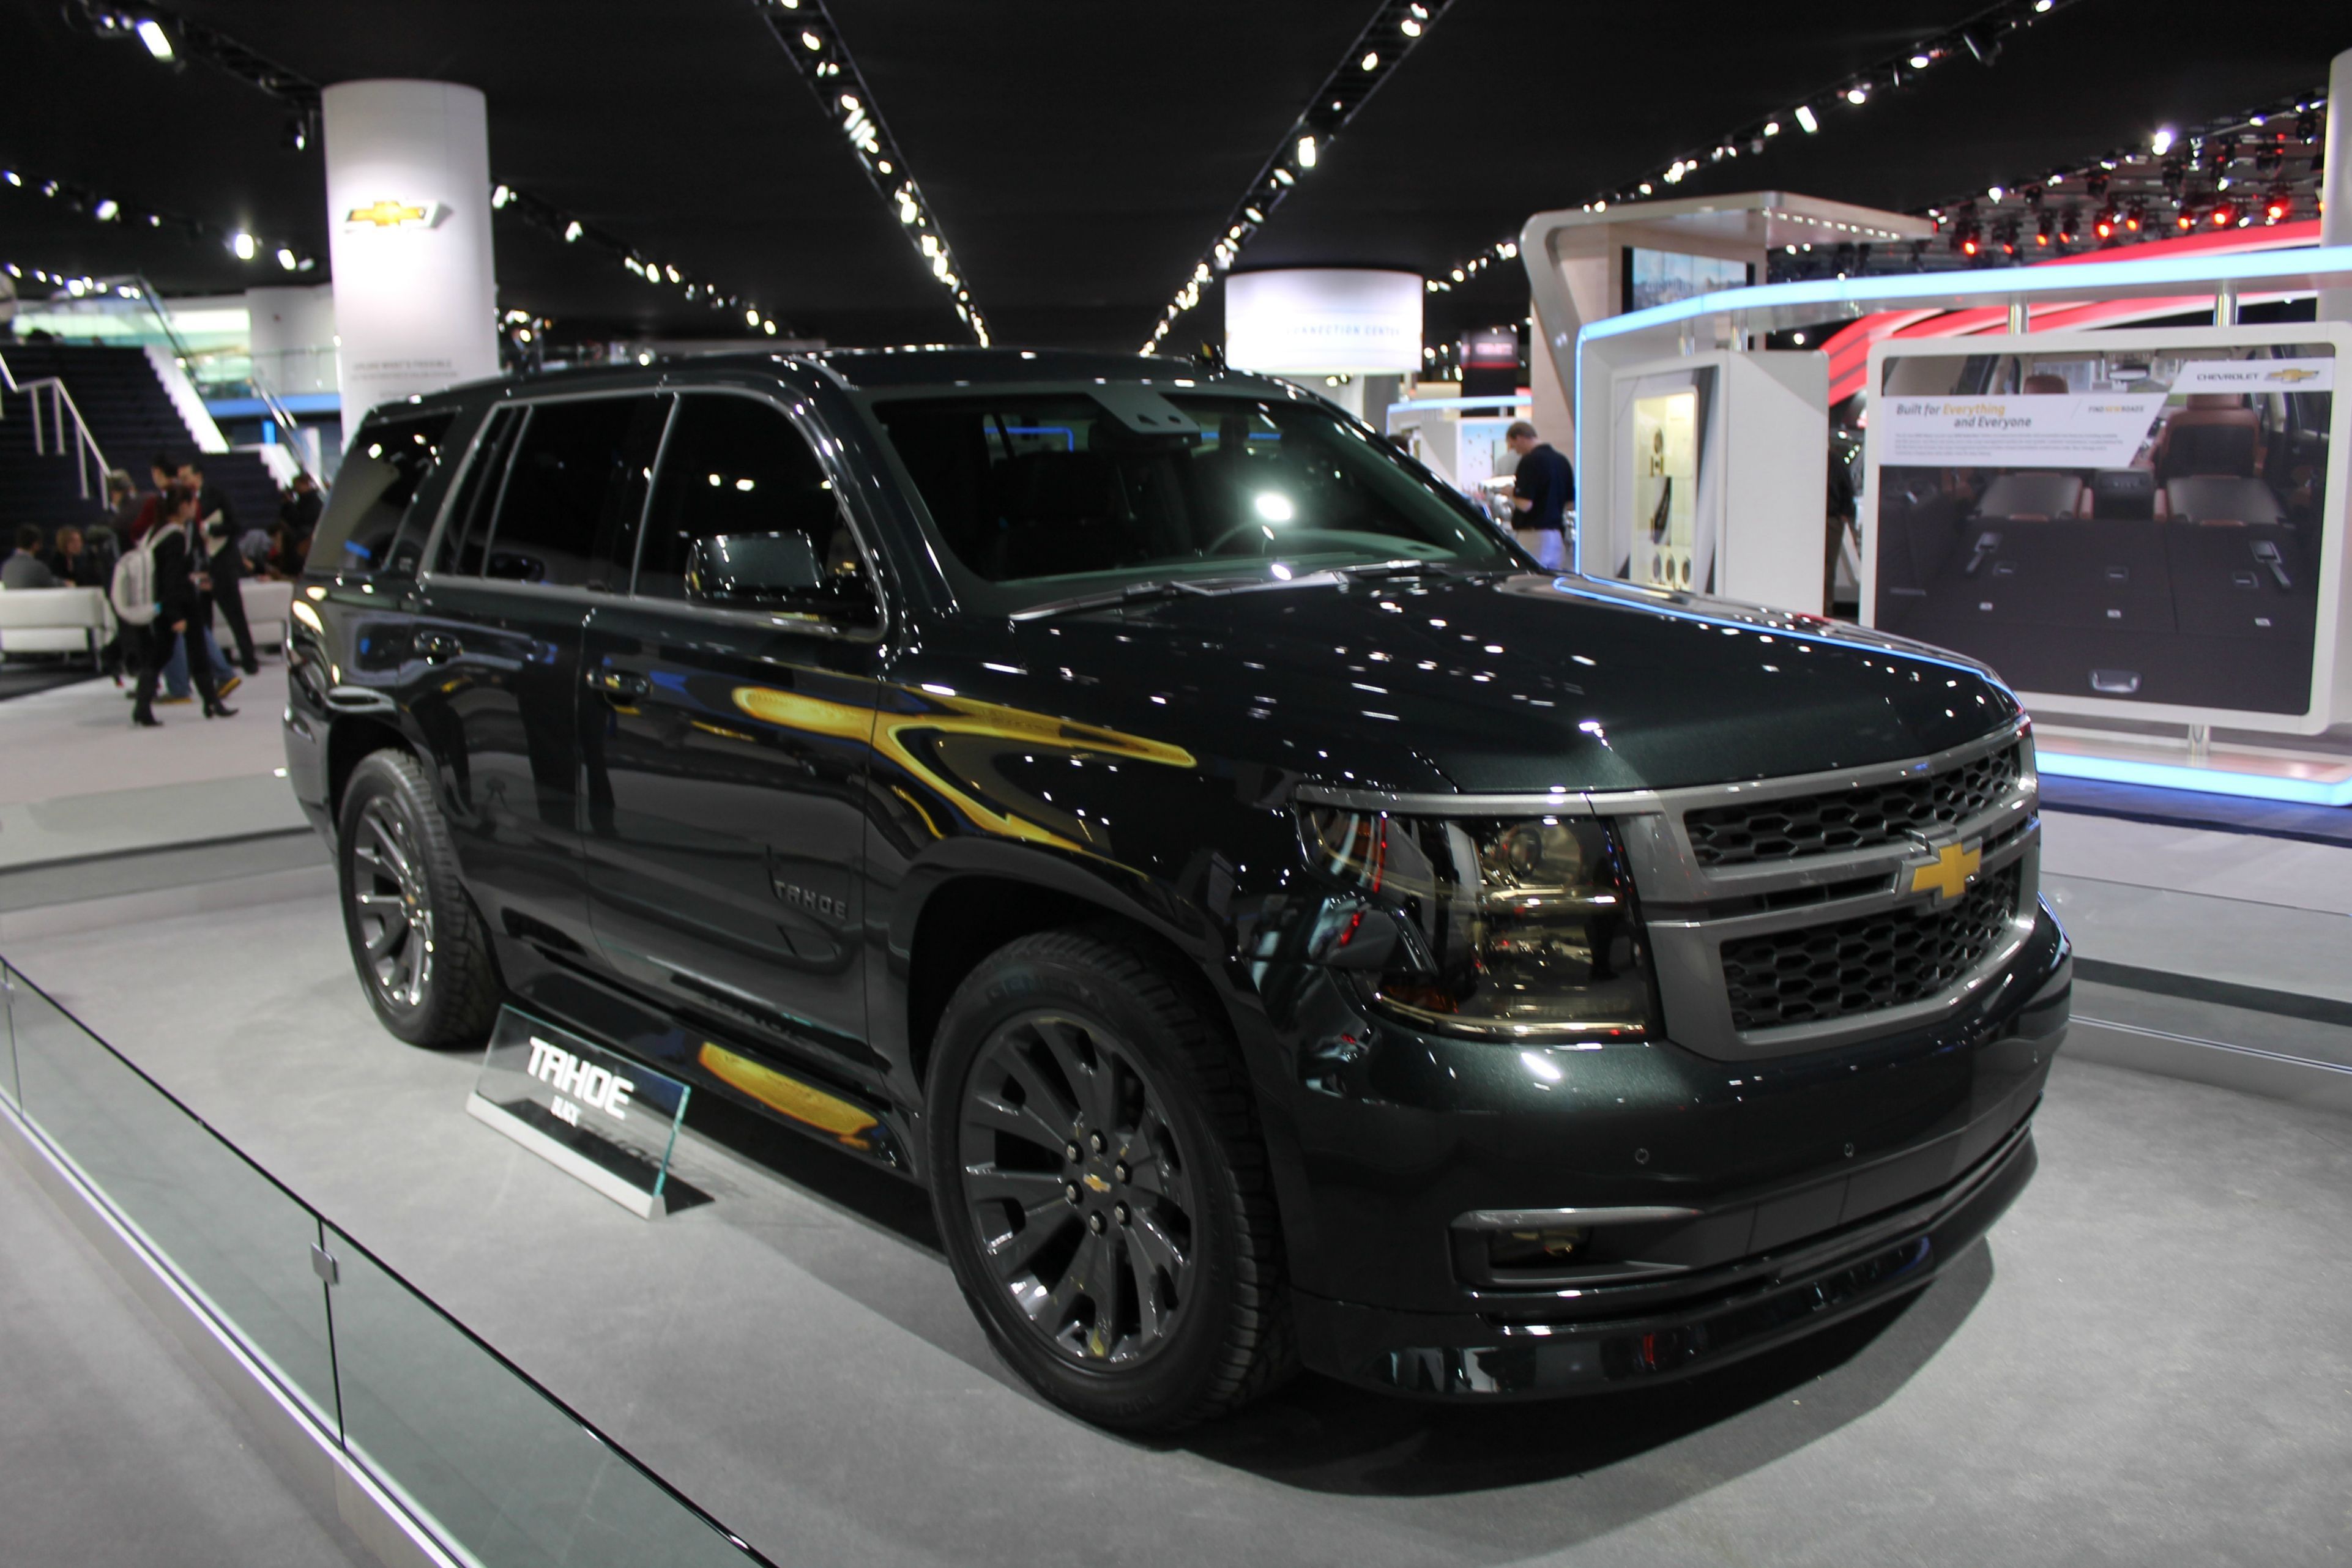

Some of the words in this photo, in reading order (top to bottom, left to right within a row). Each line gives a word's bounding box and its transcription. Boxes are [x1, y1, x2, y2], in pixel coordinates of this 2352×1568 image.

[1364, 325, 1400, 336] CENTER
[1897, 404, 1922, 415] Built
[1924, 404, 1941, 417] for
[1943, 403, 2006, 417] Everything
[1954, 416, 1975, 428] and
[1978, 417, 2031, 429] Everyone
[773, 880, 846, 920] TAHOE
[527, 1036, 635, 1120] TAHOE
